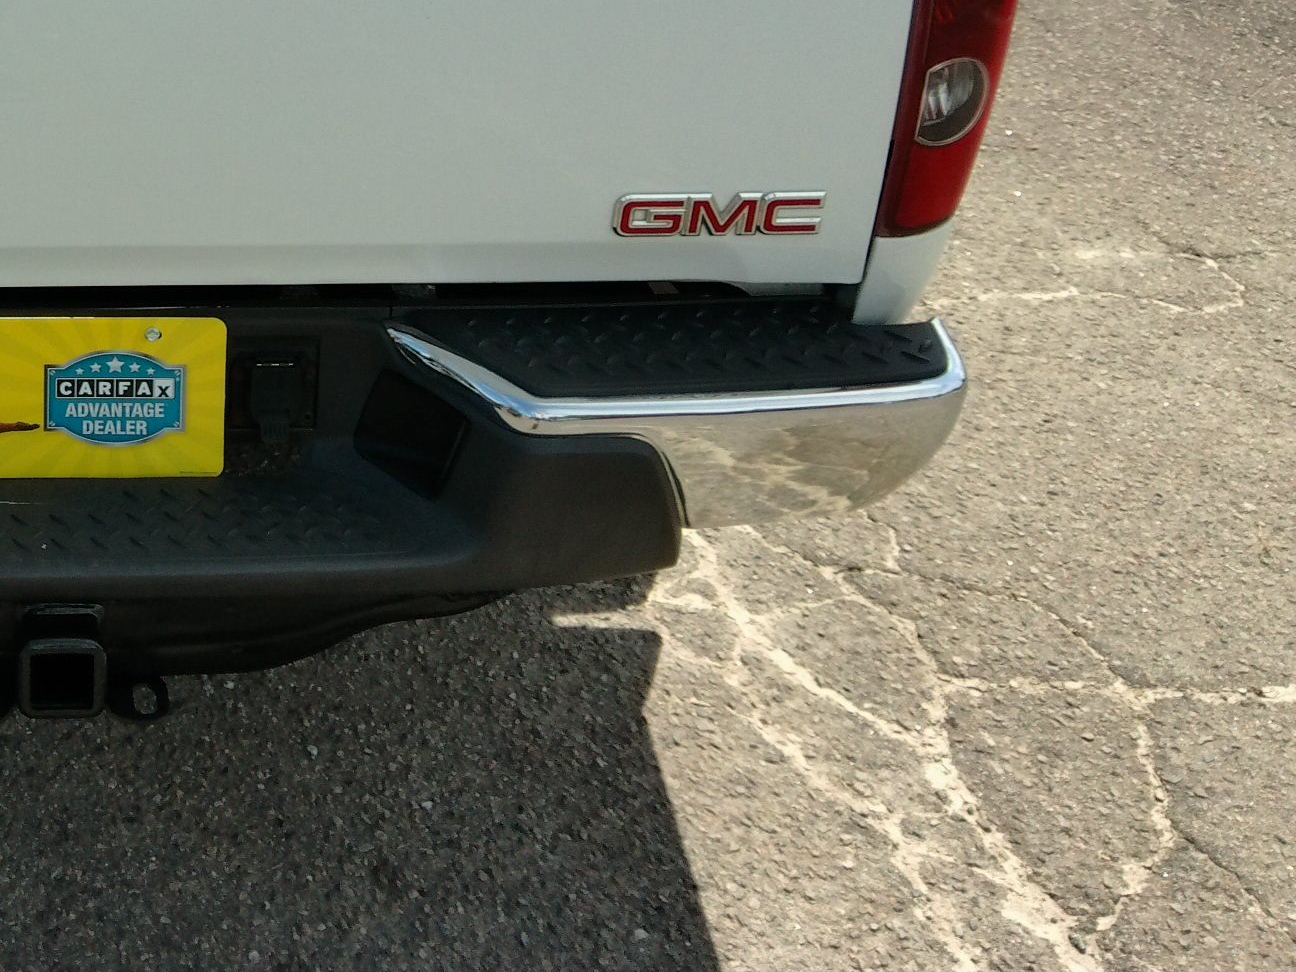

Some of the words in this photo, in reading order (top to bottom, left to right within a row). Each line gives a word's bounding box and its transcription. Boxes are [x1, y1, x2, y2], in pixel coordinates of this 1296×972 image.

[613, 190, 827, 237] GMC
[59, 380, 170, 398] CARFAX
[65, 402, 165, 418] ADVANTAGE
[82, 419, 148, 436] DEALER
